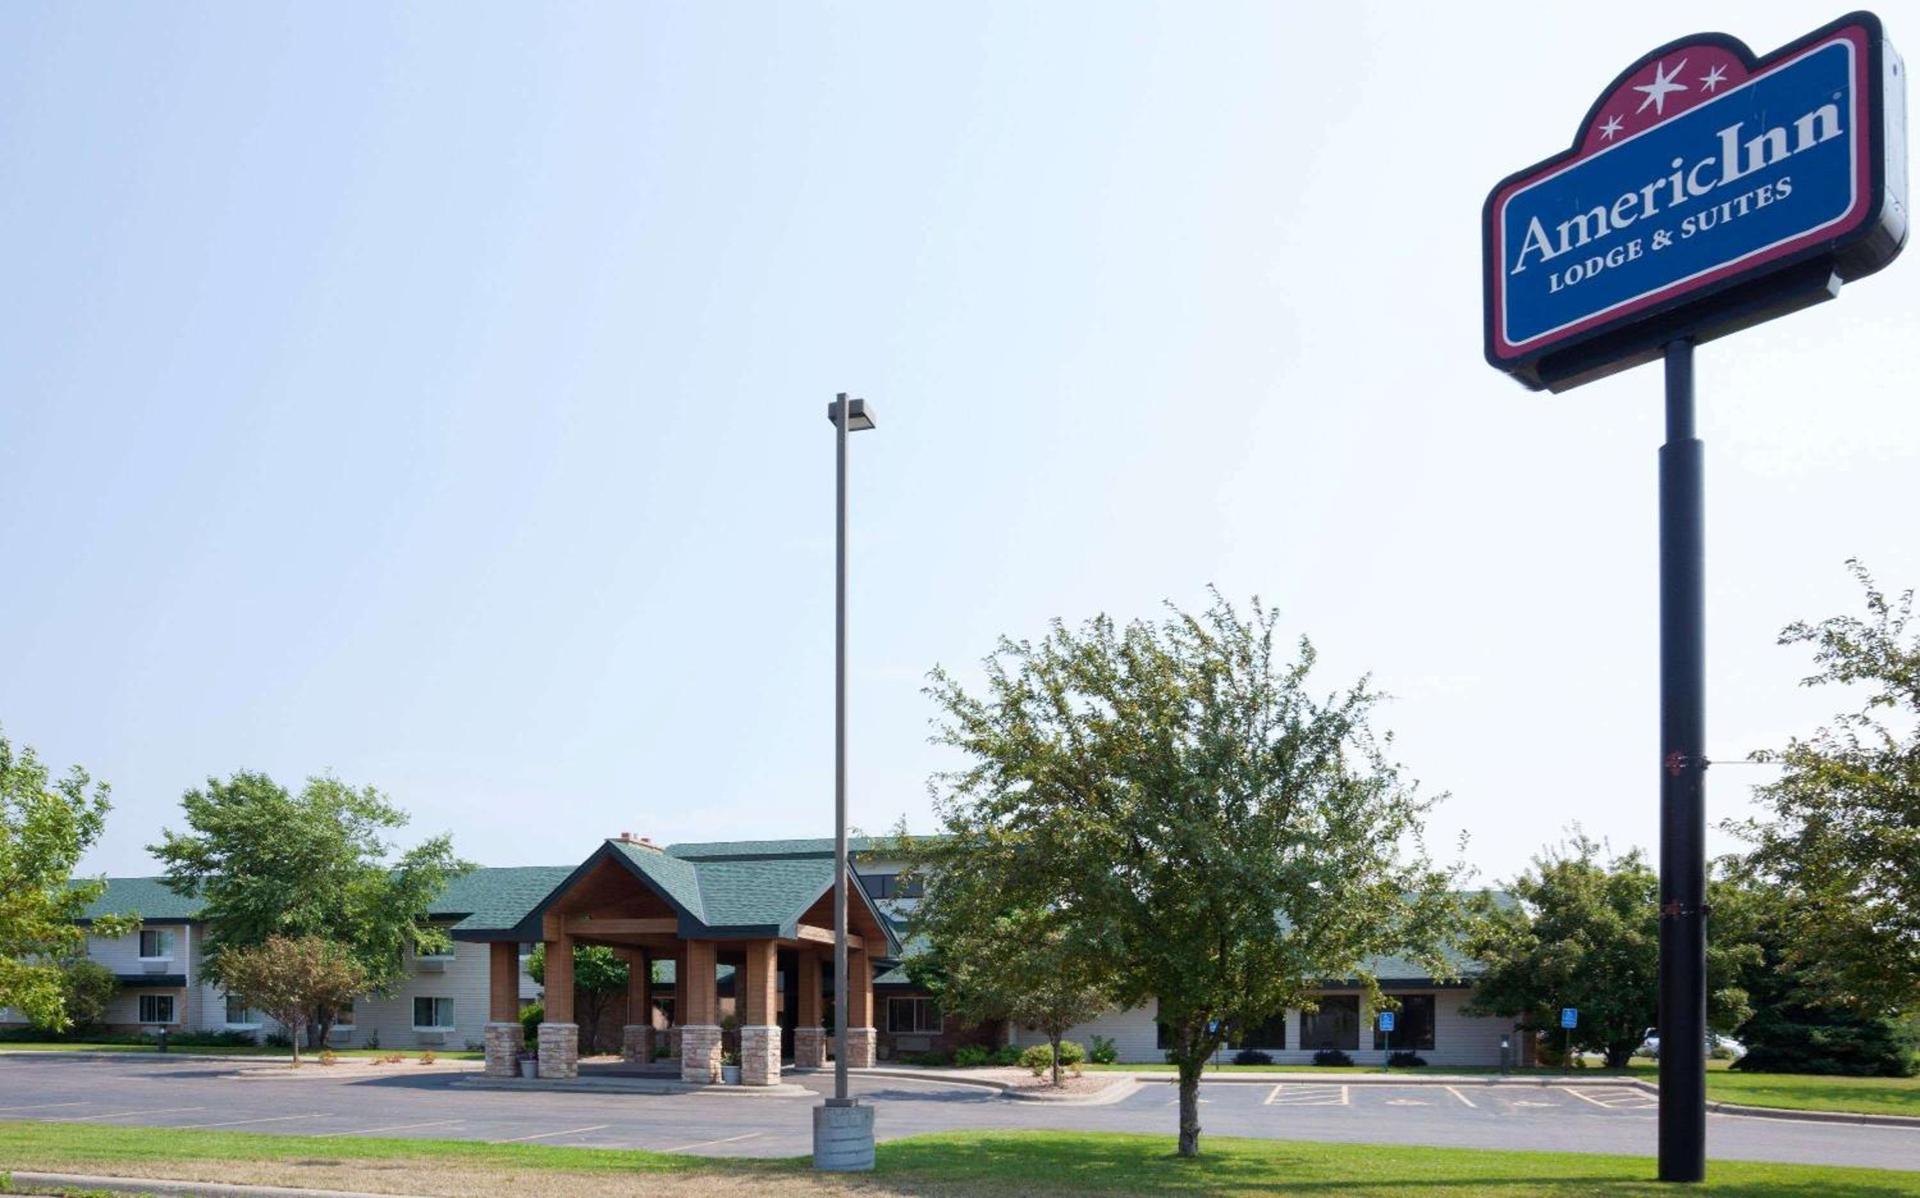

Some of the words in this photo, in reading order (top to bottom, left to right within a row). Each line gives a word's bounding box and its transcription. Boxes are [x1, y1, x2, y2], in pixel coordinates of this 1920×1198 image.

[1510, 103, 1843, 275] AmericInn
[1549, 238, 1643, 293] LODGE
[1651, 229, 1673, 252] &
[1681, 176, 1792, 238] SUITES
